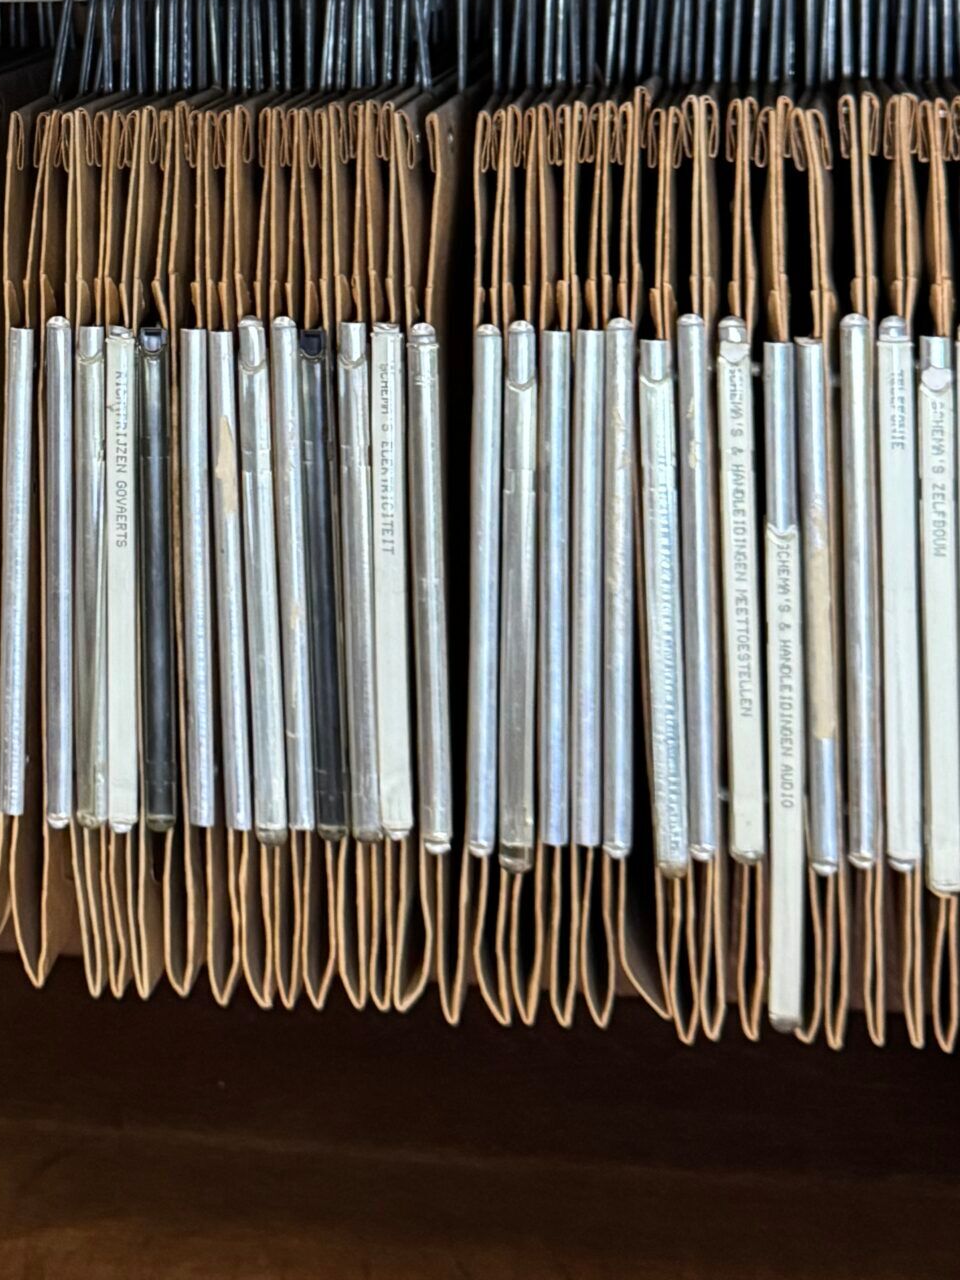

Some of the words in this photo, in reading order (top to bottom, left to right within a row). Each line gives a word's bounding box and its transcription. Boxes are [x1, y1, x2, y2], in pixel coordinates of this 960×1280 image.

[731, 446, 744, 456] &
[115, 480, 128, 548] GOVAERTS
[731, 464, 748, 582] HANDLEIDINGEN
[931, 483, 947, 558] ZELFBOUW
[776, 543, 791, 613] SCHEMA'S
[734, 588, 753, 718] MEETTOESTELLEN
[778, 622, 791, 632] &
[778, 639, 794, 756] HANDLEIDINGEN
[780, 764, 795, 809] AUDIO
